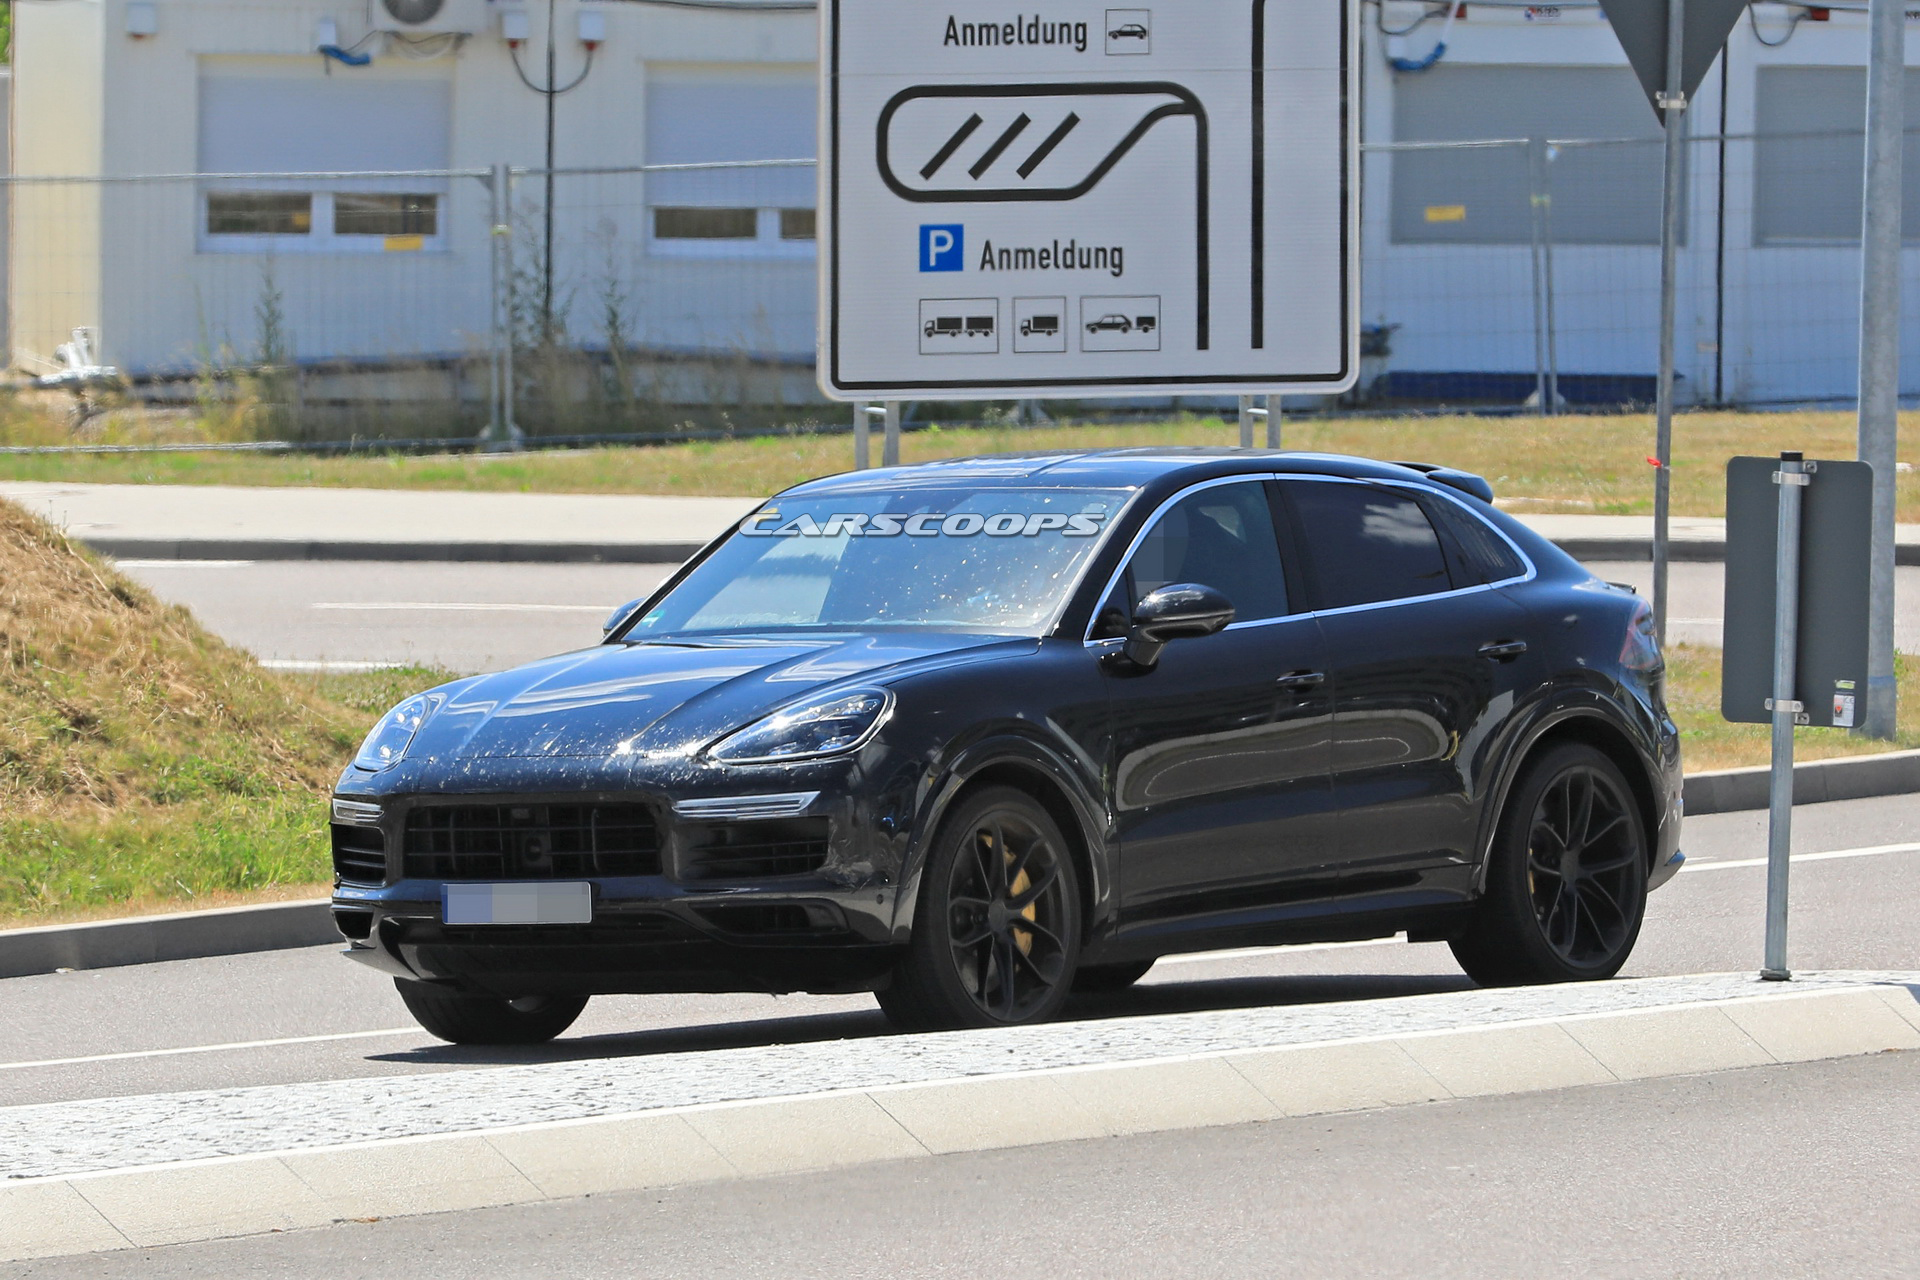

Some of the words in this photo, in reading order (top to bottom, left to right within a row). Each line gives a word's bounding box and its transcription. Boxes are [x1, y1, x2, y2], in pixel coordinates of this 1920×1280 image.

[943, 14, 1087, 52] Anmeldung
[929, 230, 953, 266] P
[980, 239, 1123, 277] Anmeldung
